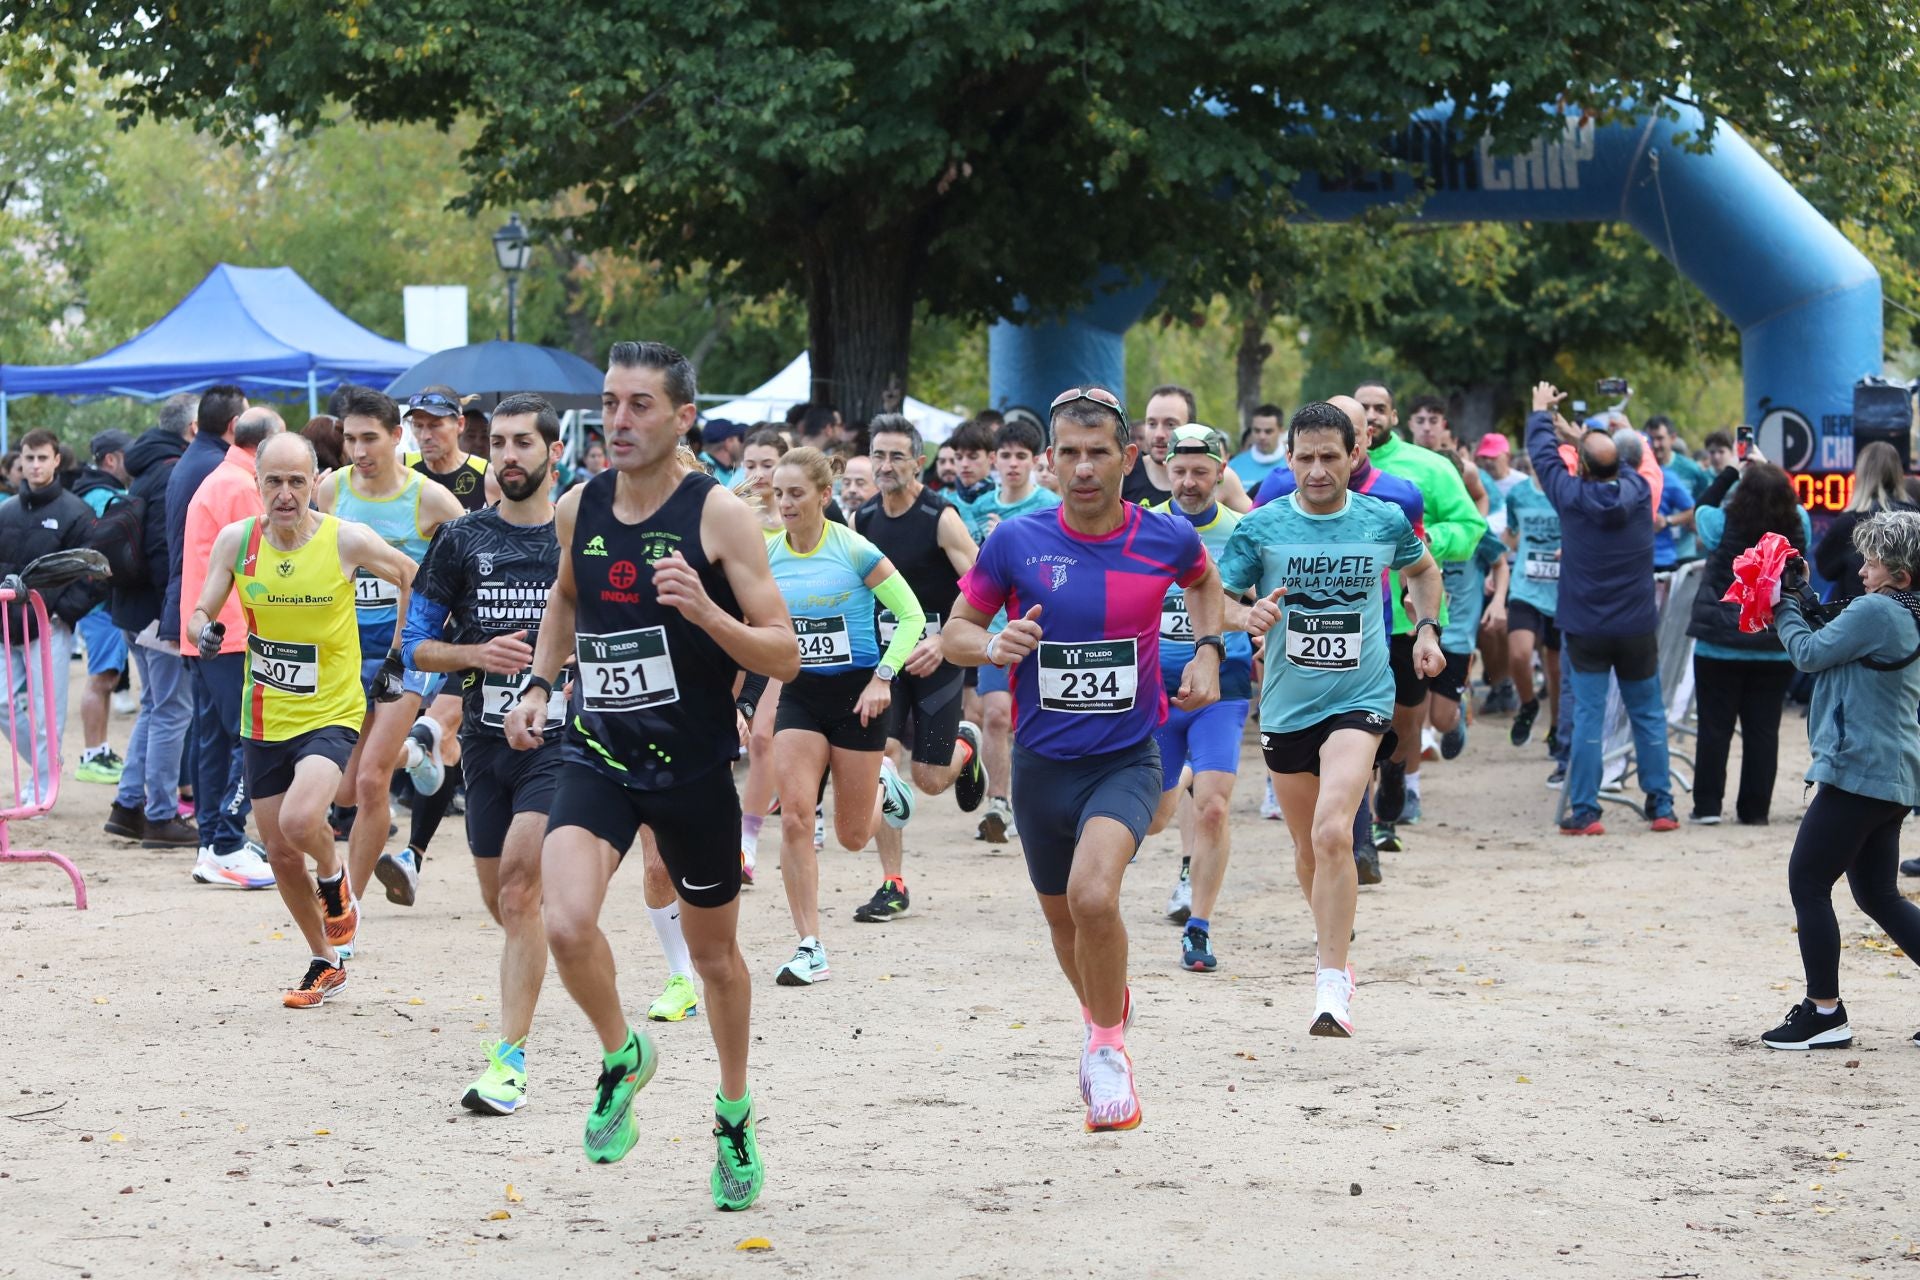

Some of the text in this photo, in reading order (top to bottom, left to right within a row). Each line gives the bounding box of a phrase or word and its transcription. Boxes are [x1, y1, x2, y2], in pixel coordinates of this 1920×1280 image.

[1040, 554, 1053, 562] LOS
[1053, 555, 1078, 565] FIERAS
[1287, 551, 1374, 575] MUÉVETE
[355, 580, 380, 599] 11
[1282, 577, 1375, 588] POR LA DIABETES
[267, 594, 333, 604] Unicaja Banco
[601, 591, 639, 603] INDAS
[609, 642, 639, 652] TOLEDO
[798, 636, 834, 656] 349
[1084, 650, 1113, 658] TOLEDO
[1300, 636, 1347, 659] 203
[262, 659, 301, 683] 307
[596, 664, 648, 695] 251
[1061, 671, 1119, 698] 234
